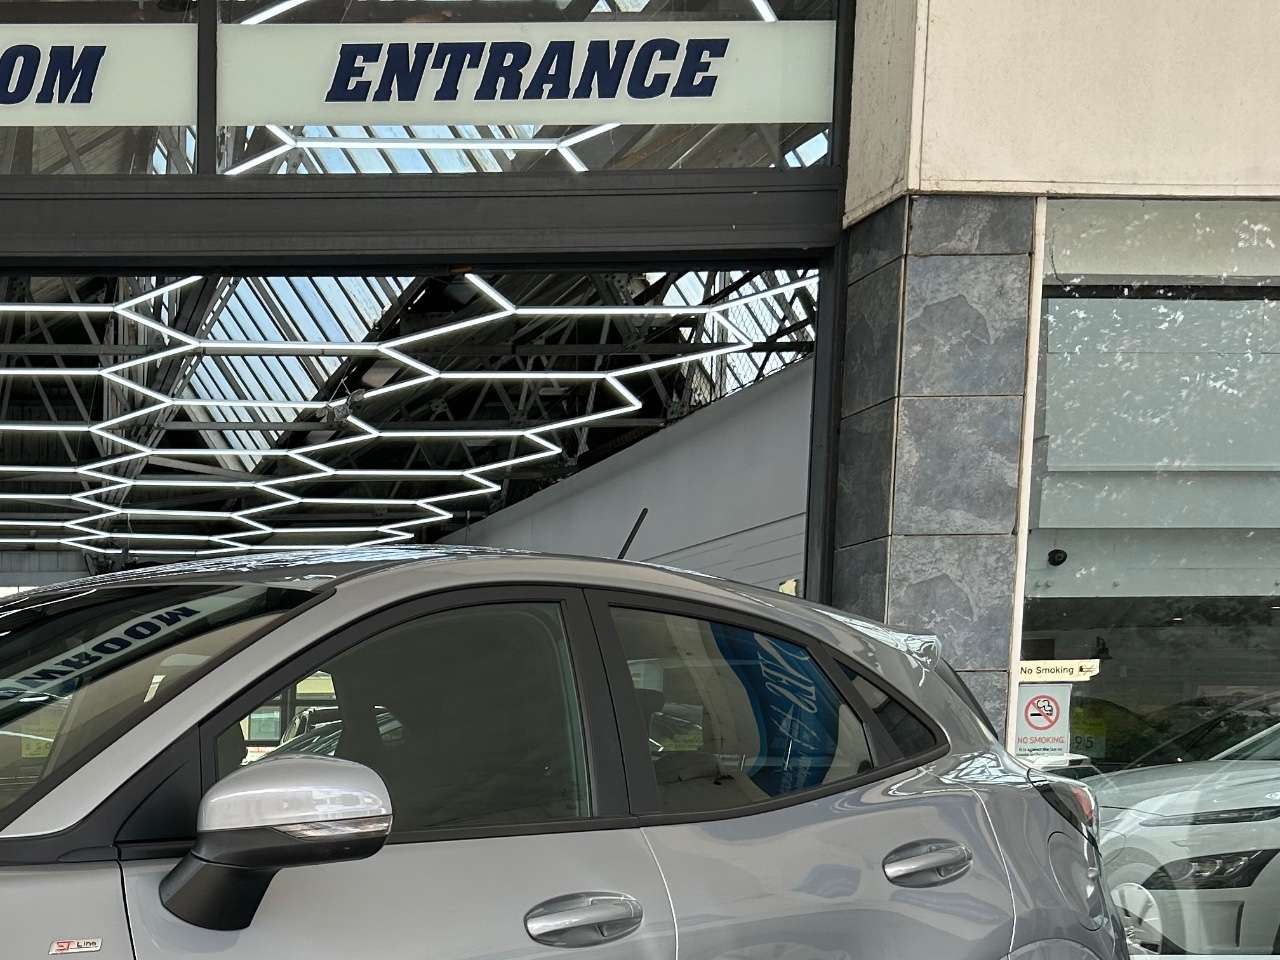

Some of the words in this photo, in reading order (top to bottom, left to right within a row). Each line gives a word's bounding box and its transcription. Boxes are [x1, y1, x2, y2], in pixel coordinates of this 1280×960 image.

[324, 38, 729, 102] ENTRANCE
[1020, 666, 1033, 675] No
[1036, 665, 1074, 675] Smoking
[1017, 736, 1028, 744] NO
[1029, 736, 1065, 744] SMOKING
